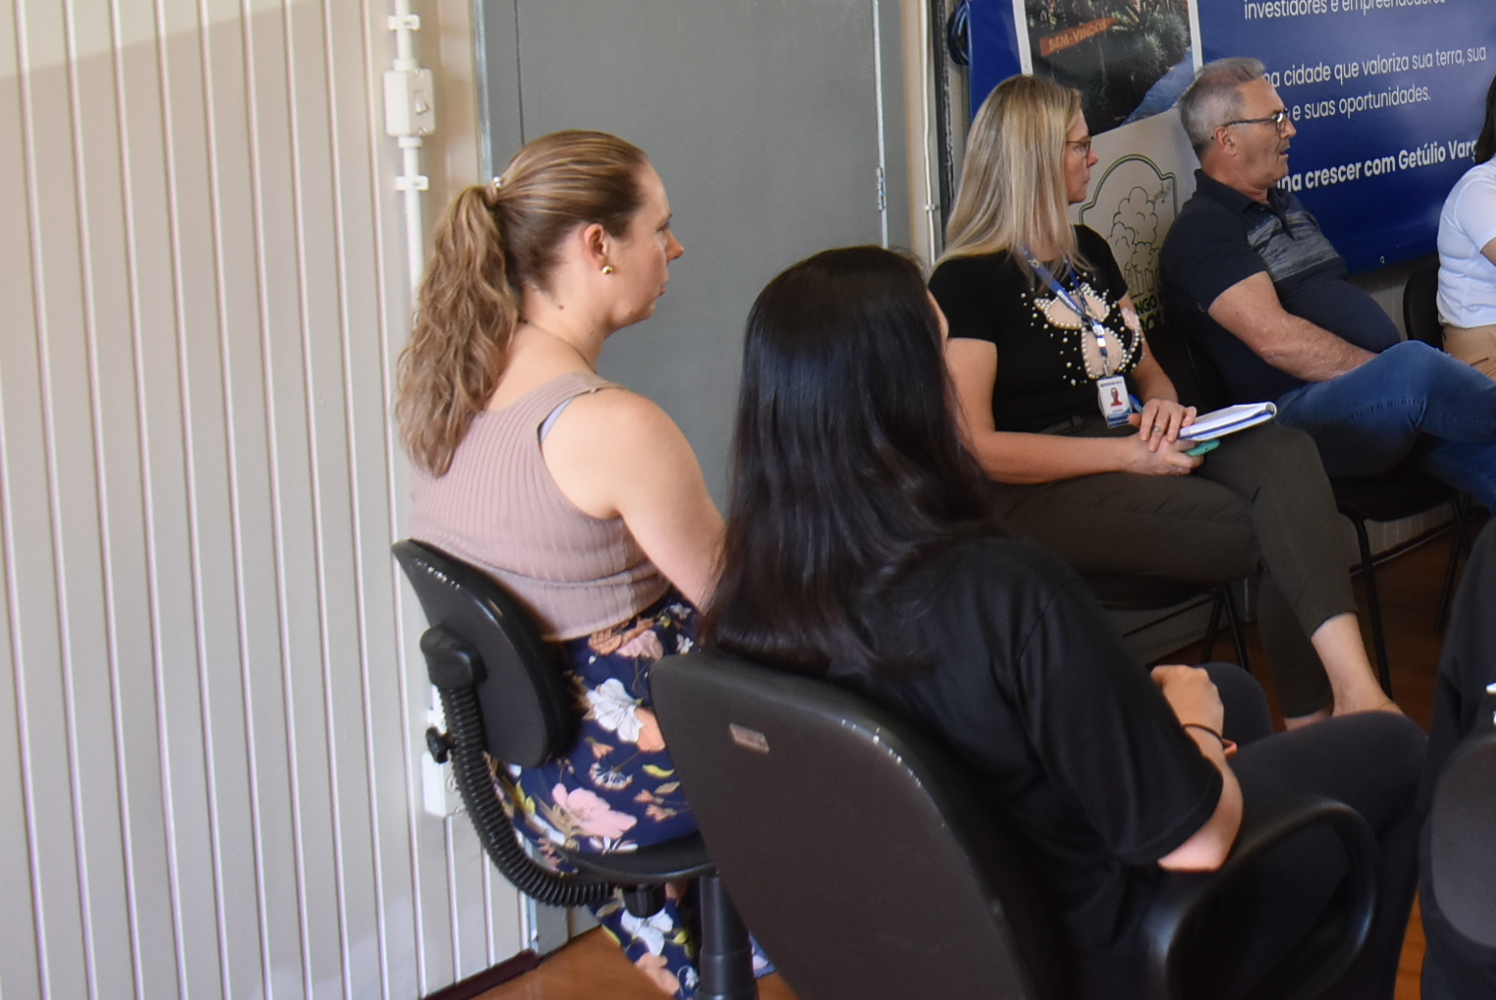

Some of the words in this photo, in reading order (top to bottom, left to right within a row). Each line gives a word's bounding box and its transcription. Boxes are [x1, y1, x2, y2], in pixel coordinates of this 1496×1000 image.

[1284, 61, 1331, 87] cidade
[1334, 62, 1360, 85] que
[1362, 51, 1409, 77] valoriza
[1412, 53, 1433, 69] sua
[1436, 48, 1465, 68] terra,
[1467, 46, 1487, 62] sua
[1292, 104, 1301, 121] e
[1304, 99, 1336, 119] suas
[1339, 84, 1431, 118] oportunidades.
[1305, 165, 1361, 190] crescer
[1364, 154, 1396, 178] com
[1398, 141, 1446, 171] Getúlio
